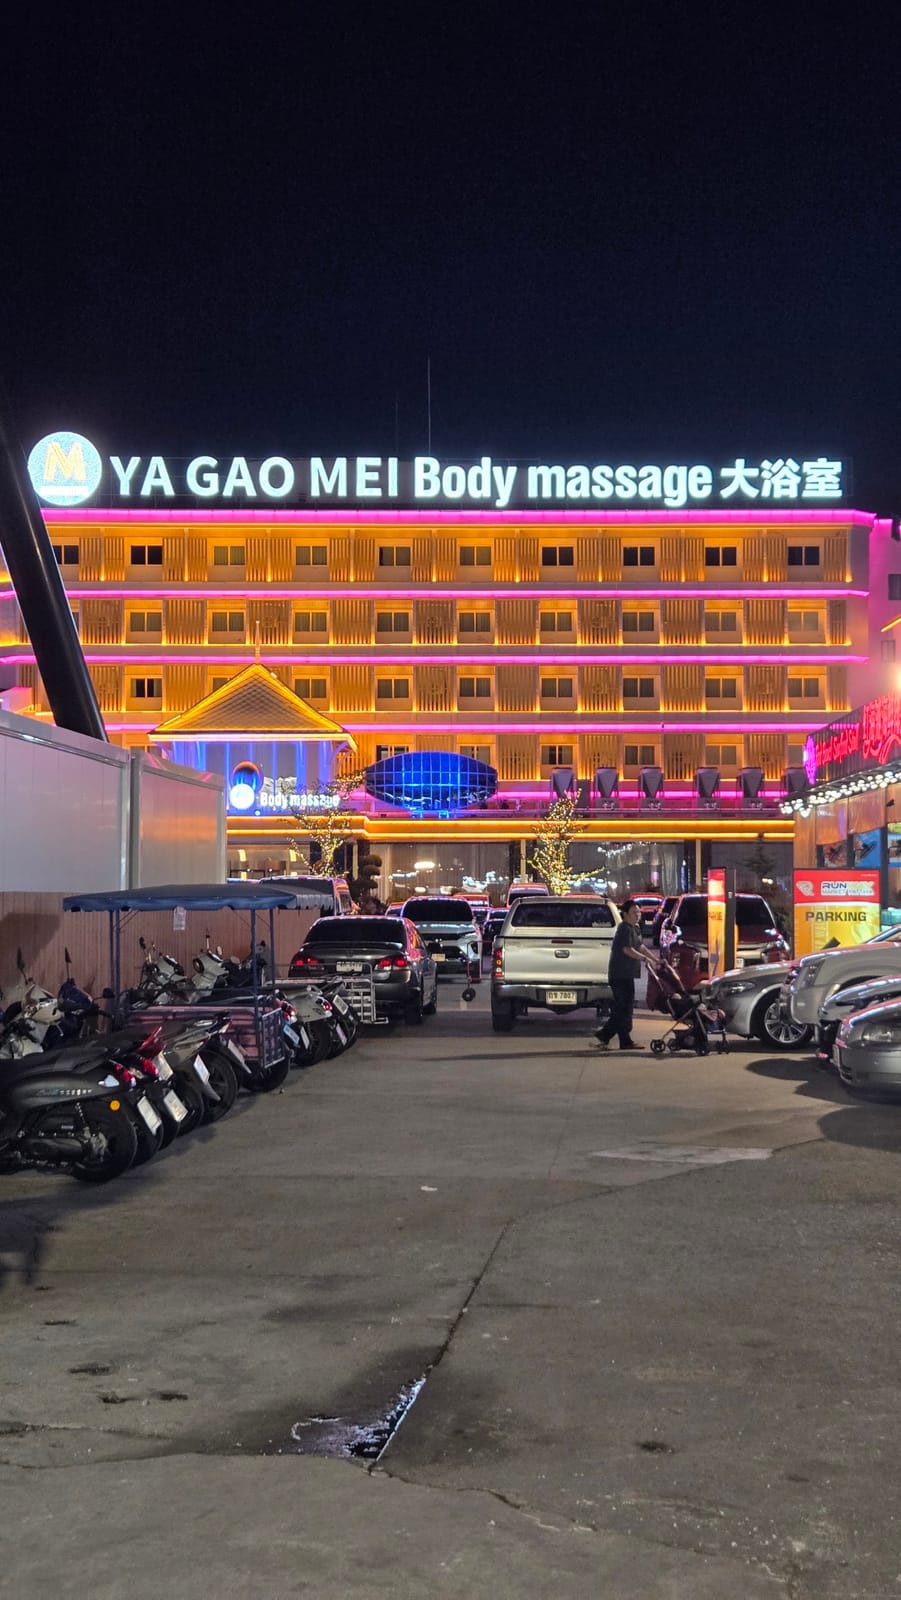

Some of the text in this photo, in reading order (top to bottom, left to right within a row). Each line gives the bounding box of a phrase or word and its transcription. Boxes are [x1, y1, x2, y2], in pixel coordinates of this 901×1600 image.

[109, 455, 713, 508] YA GAO MEI Body massage
[719, 457, 843, 499] 大浴室
[260, 792, 287, 809] Body
[805, 911, 867, 922] PARKING
